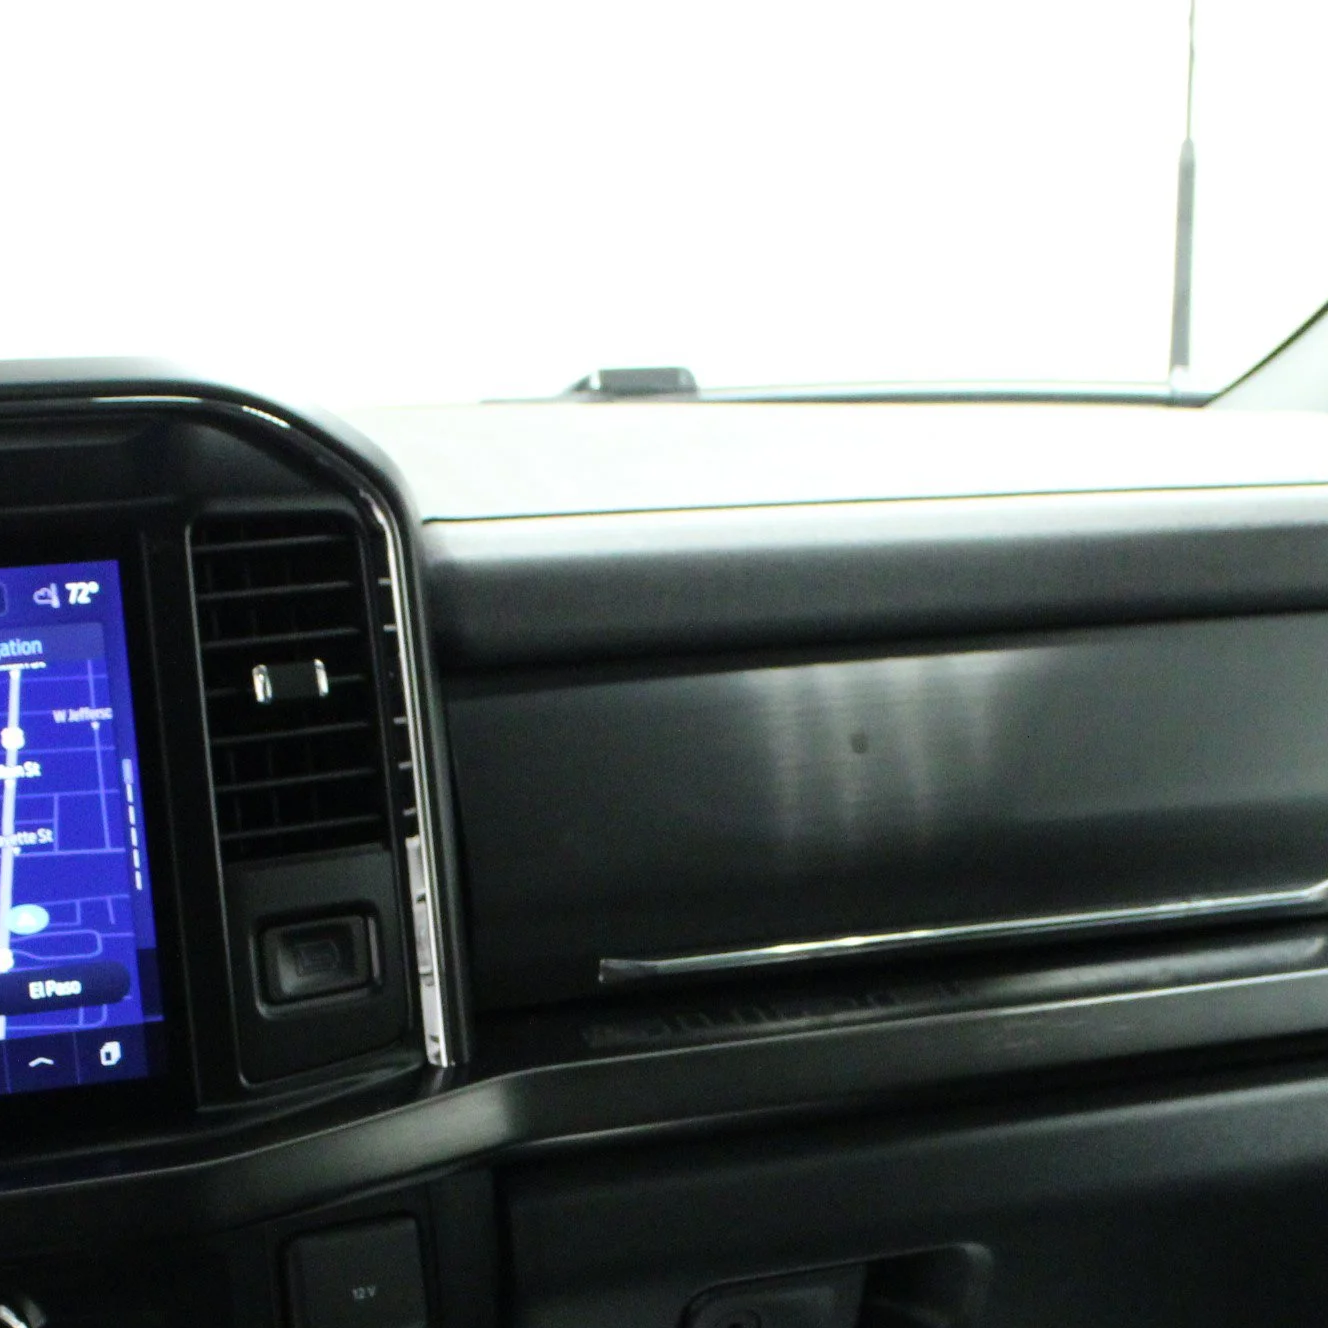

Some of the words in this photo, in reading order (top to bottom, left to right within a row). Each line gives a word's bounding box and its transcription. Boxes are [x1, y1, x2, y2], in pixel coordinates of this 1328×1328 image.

[53, 709, 66, 723] W
[37, 828, 53, 843] St
[45, 980, 82, 997] Paso
